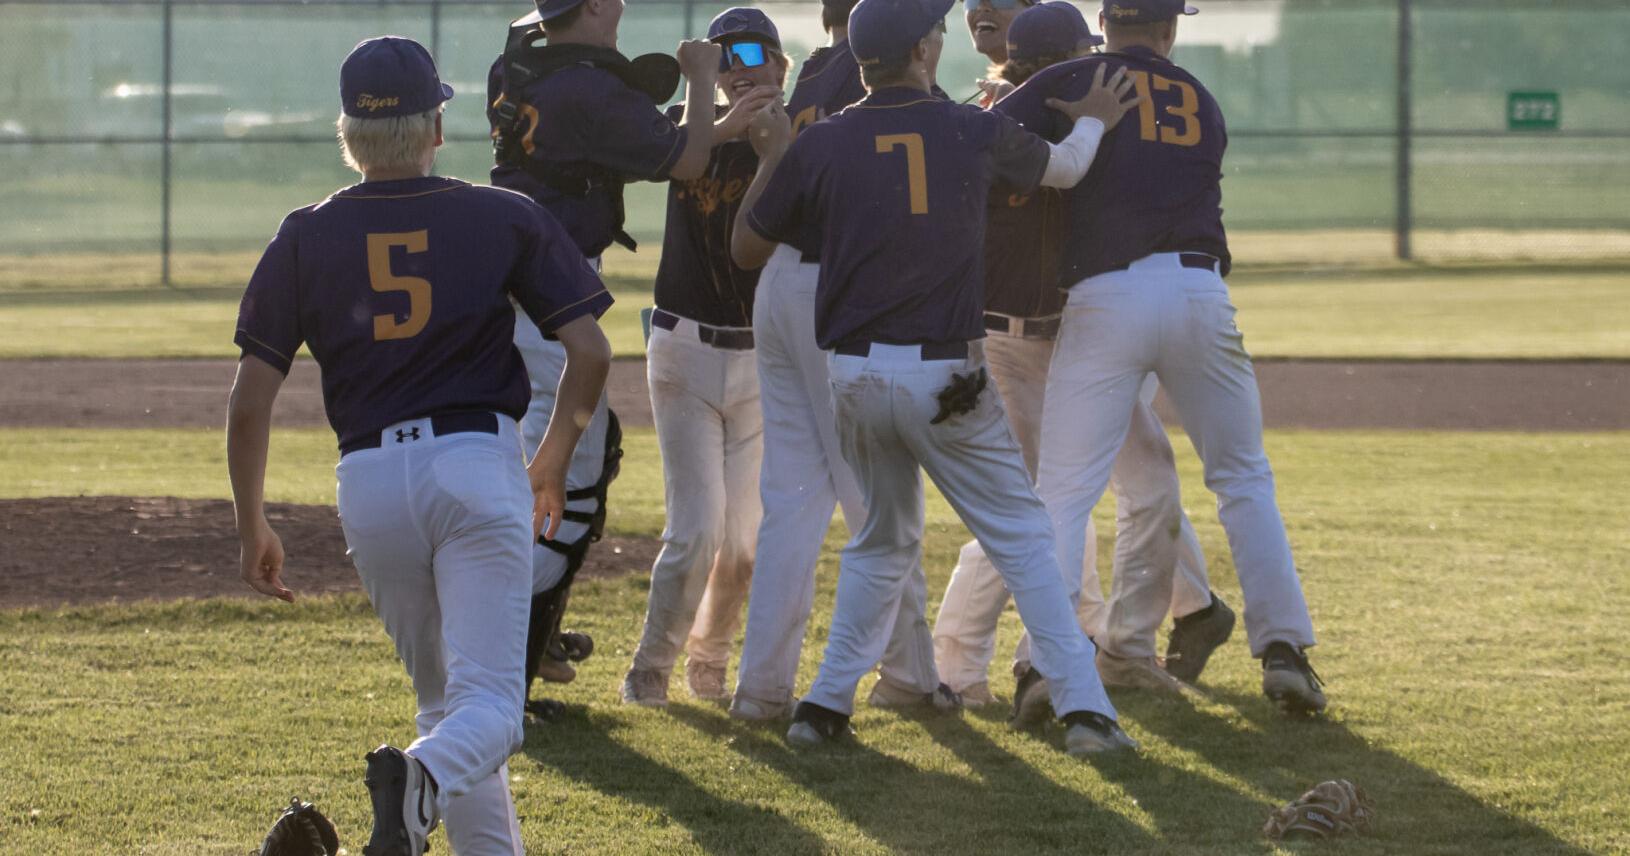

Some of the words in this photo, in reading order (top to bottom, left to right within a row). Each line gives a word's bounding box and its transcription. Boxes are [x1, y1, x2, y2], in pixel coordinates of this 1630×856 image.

[356, 93, 400, 113] Tigers
[1124, 69, 1202, 147] 13
[875, 133, 929, 215] 7
[366, 229, 433, 341] 5
